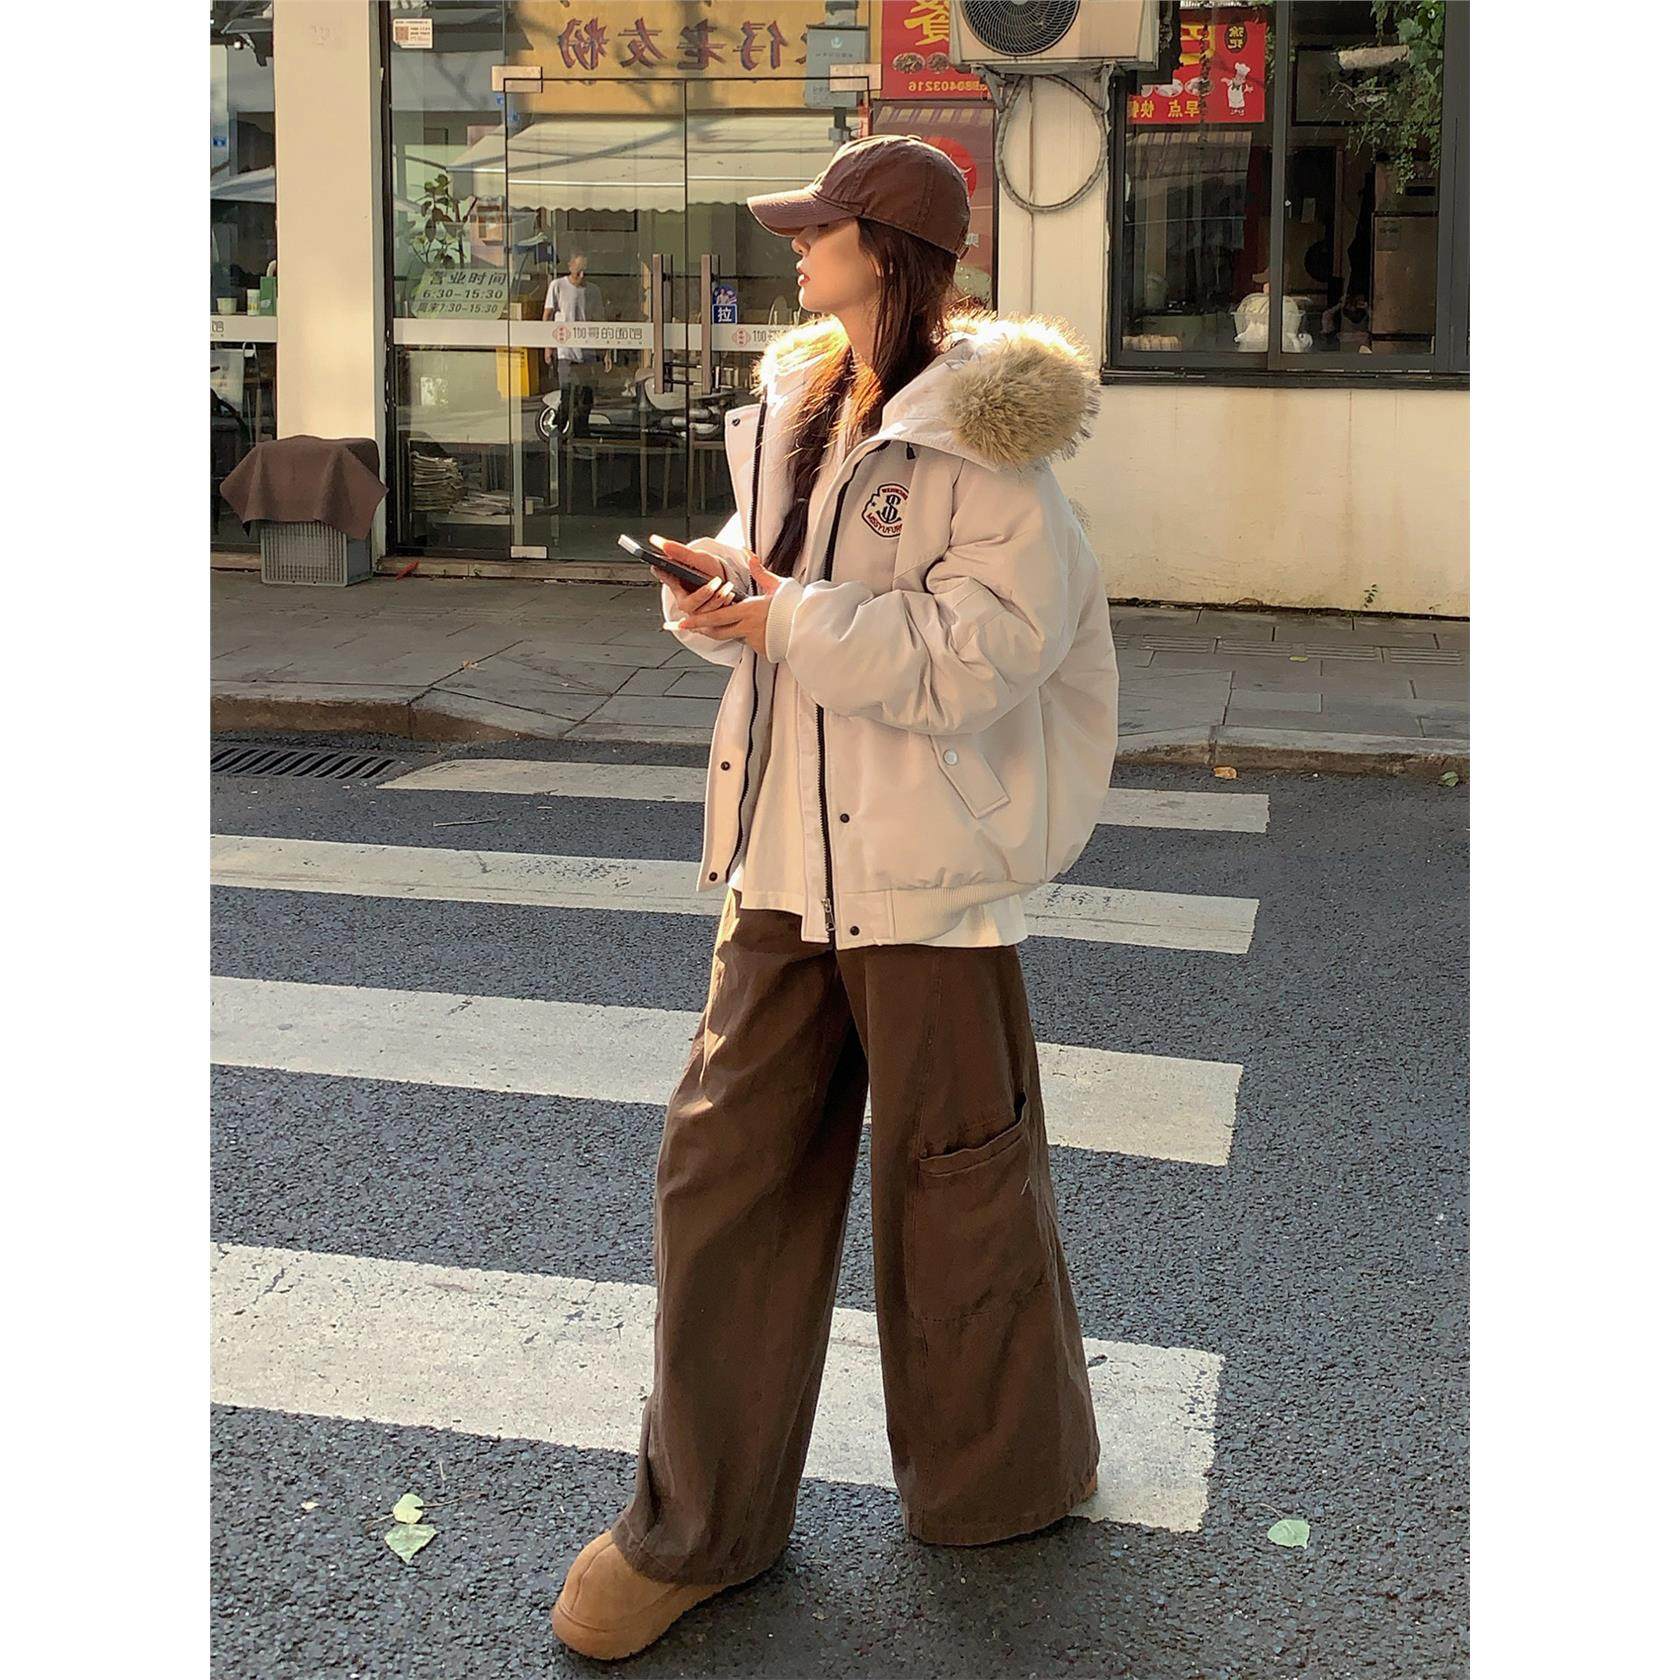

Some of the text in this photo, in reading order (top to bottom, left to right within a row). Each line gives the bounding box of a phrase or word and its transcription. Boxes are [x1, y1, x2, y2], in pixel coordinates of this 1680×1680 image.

[430, 270, 507, 286] 营业时间
[718, 306, 733, 322] 拉
